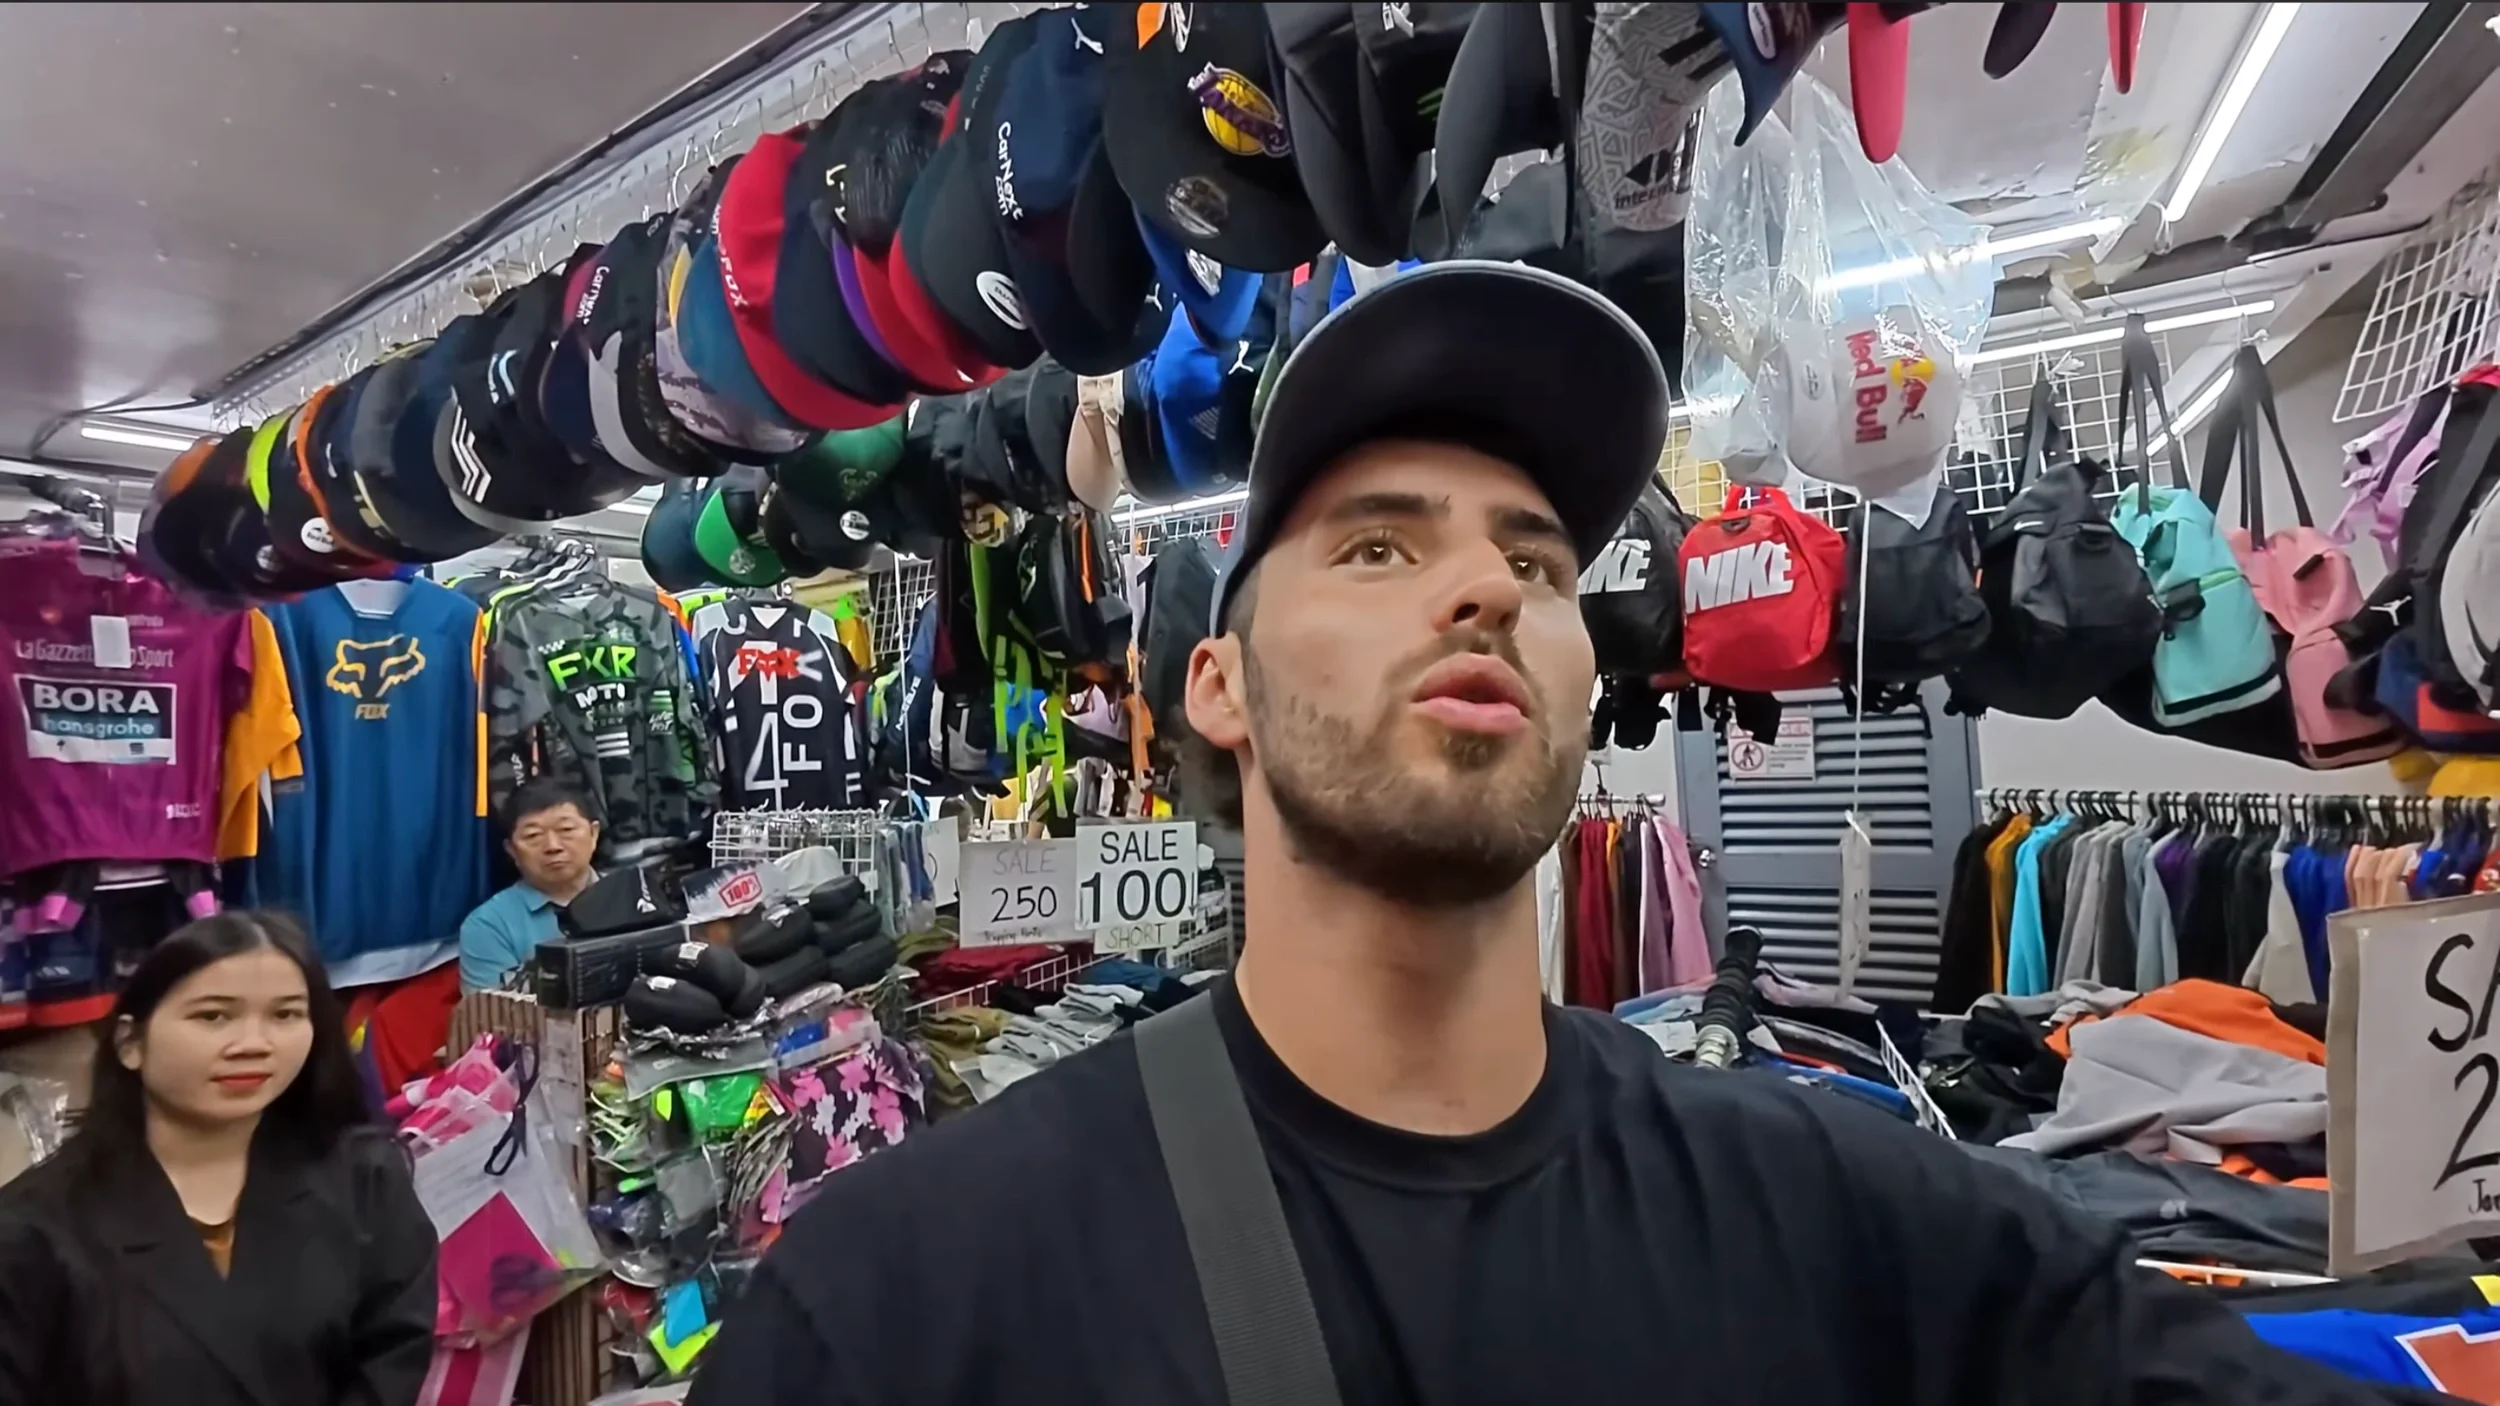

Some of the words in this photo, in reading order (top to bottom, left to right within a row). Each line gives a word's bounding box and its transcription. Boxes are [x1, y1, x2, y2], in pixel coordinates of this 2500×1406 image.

[998, 121, 1024, 220] CarNext
[1844, 328, 1887, 379] Red
[1855, 384, 1888, 443] Bull
[1684, 540, 1794, 614] NIKE
[33, 683, 160, 714] BORA
[355, 703, 390, 720] FOX
[42, 713, 155, 738] hansgrohe
[993, 850, 1056, 876] SALE
[1100, 830, 1178, 864] SALE
[991, 886, 1057, 923] 250
[1081, 868, 1187, 923] 100
[1105, 922, 1167, 949] SHORT
